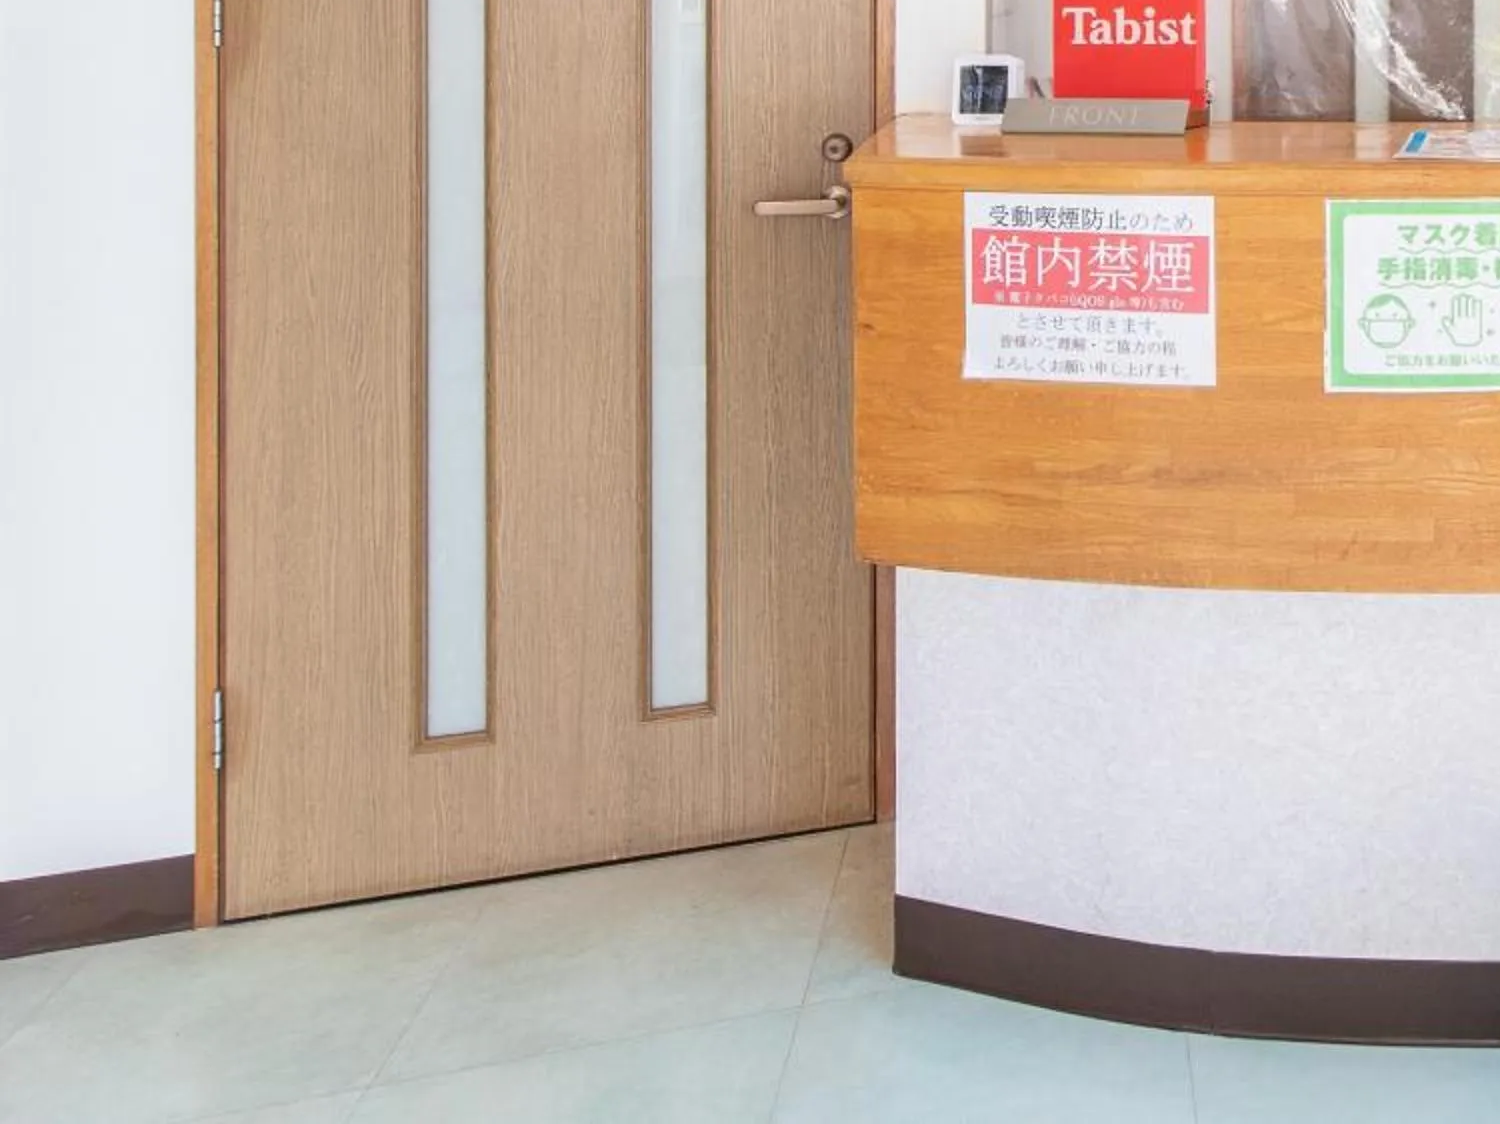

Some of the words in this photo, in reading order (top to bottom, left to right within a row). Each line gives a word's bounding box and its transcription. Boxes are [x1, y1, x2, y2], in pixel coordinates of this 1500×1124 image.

[1061, 5, 1198, 46] Tabist
[1048, 105, 1139, 126] FRONT
[989, 204, 1193, 231] 受動喫煙防止のため
[981, 235, 1195, 293] 館内禁煙
[1017, 313, 1163, 338] とさせて頂きます。
[995, 355, 1190, 378] よろしくお願い申し上げます。
